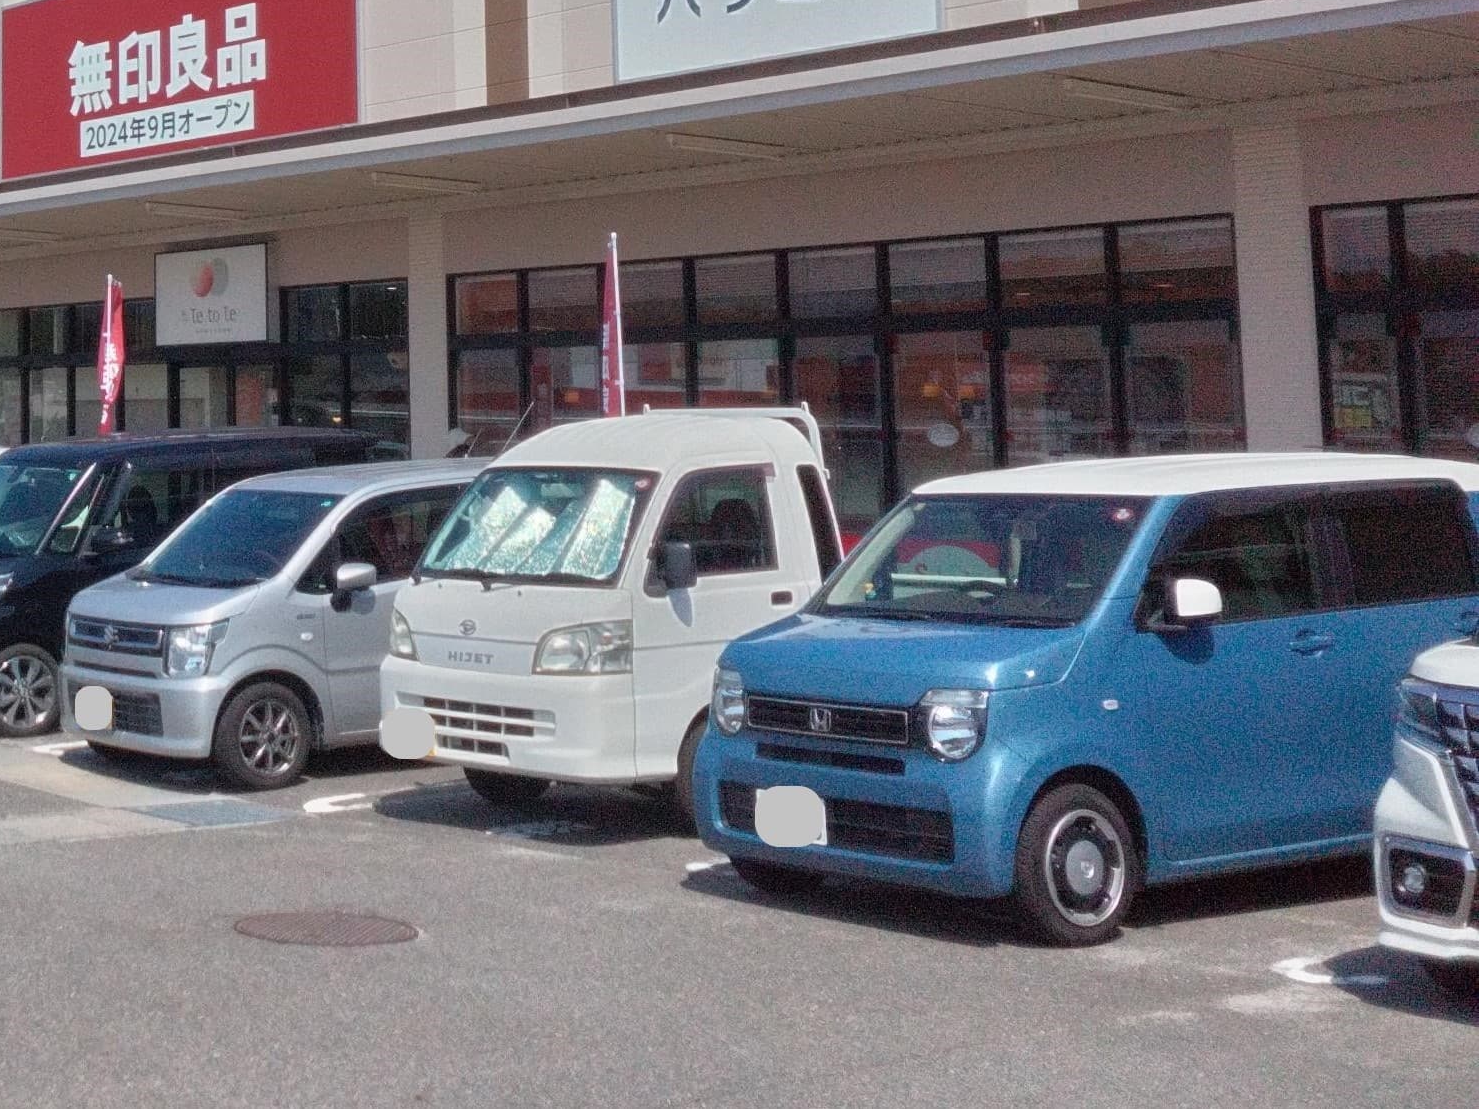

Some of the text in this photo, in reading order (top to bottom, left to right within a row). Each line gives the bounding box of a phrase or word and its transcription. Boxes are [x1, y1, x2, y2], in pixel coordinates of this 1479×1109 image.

[68, 2, 267, 117] 無印良品
[85, 99, 250, 151] 2024年9月オープン
[448, 650, 495, 665] HIJET
